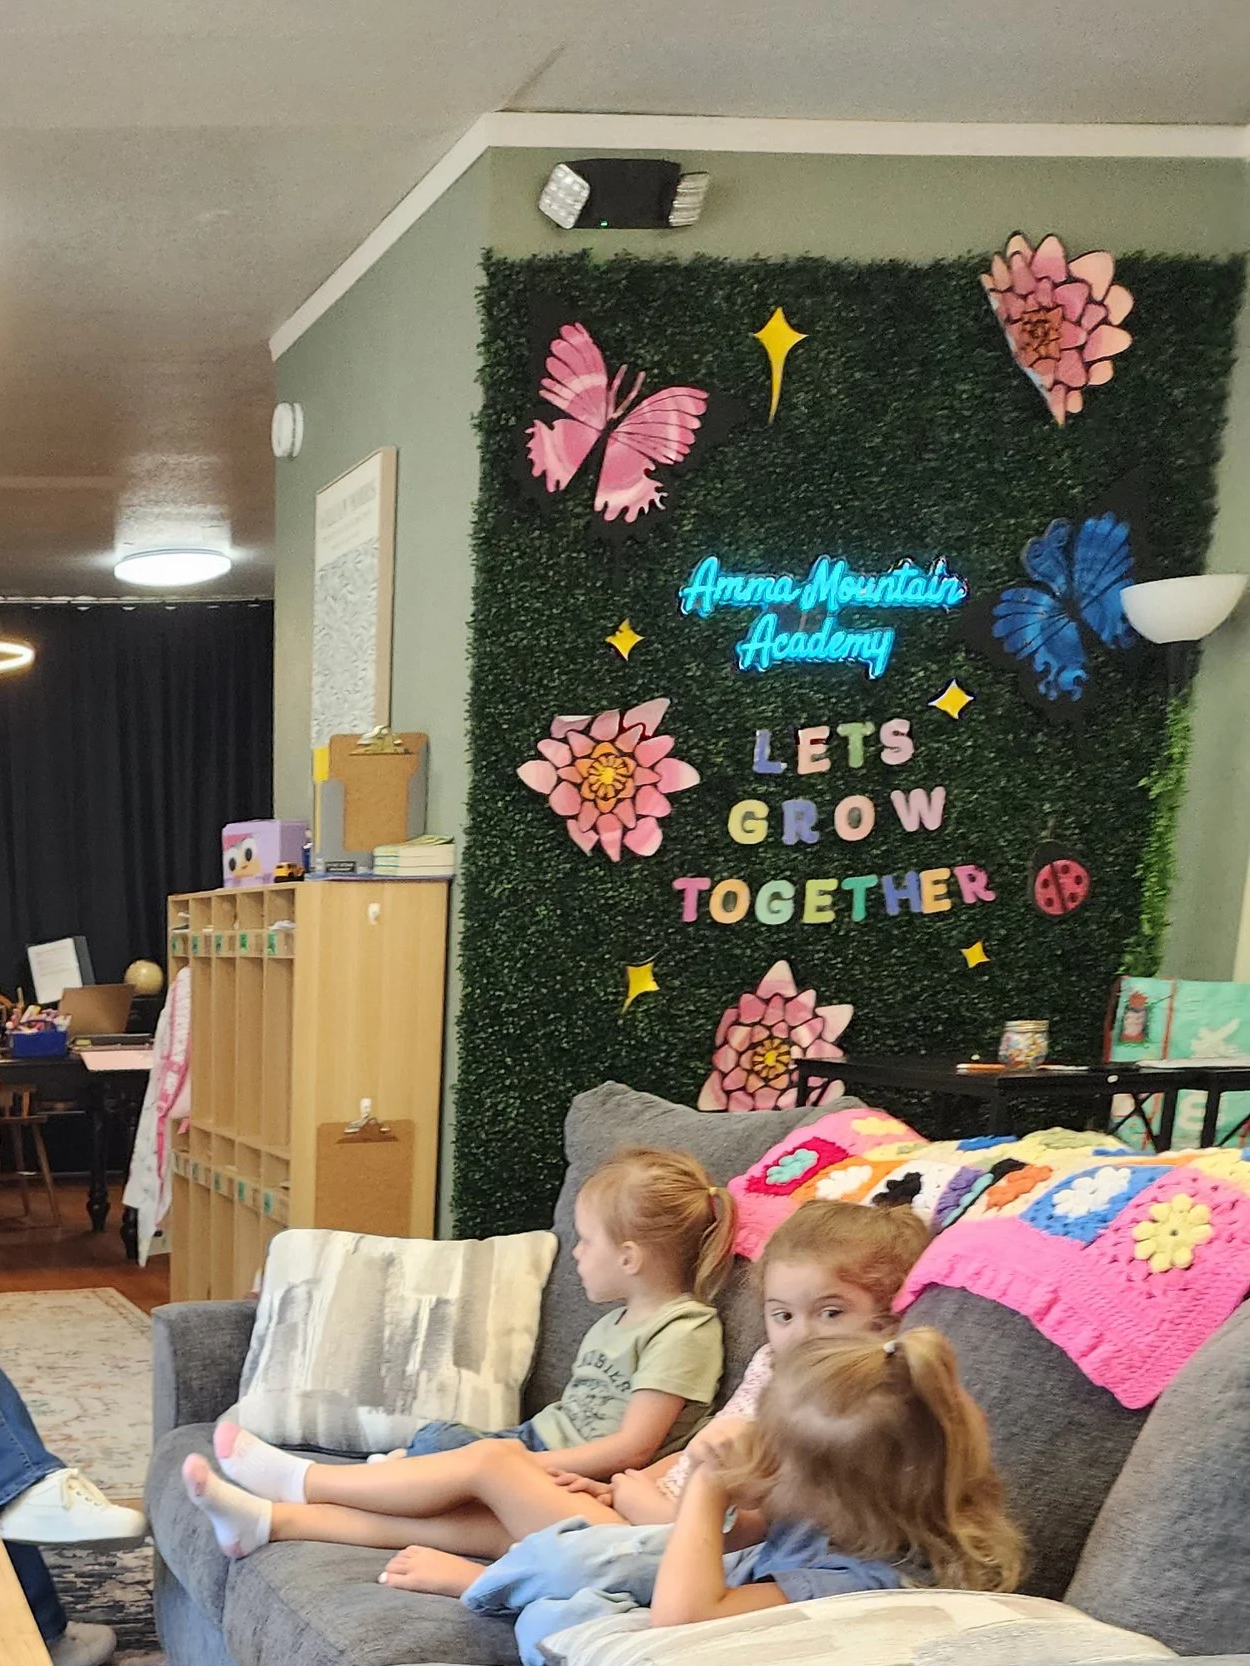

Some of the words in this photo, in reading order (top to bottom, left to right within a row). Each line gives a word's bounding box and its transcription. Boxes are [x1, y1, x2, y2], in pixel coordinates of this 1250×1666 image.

[679, 555, 801, 615] Amma
[798, 554, 968, 612] Mountain
[735, 611, 894, 679] Academy
[752, 718, 914, 775] LETS
[728, 786, 947, 845] GROW
[672, 864, 996, 925] TOGETHER
